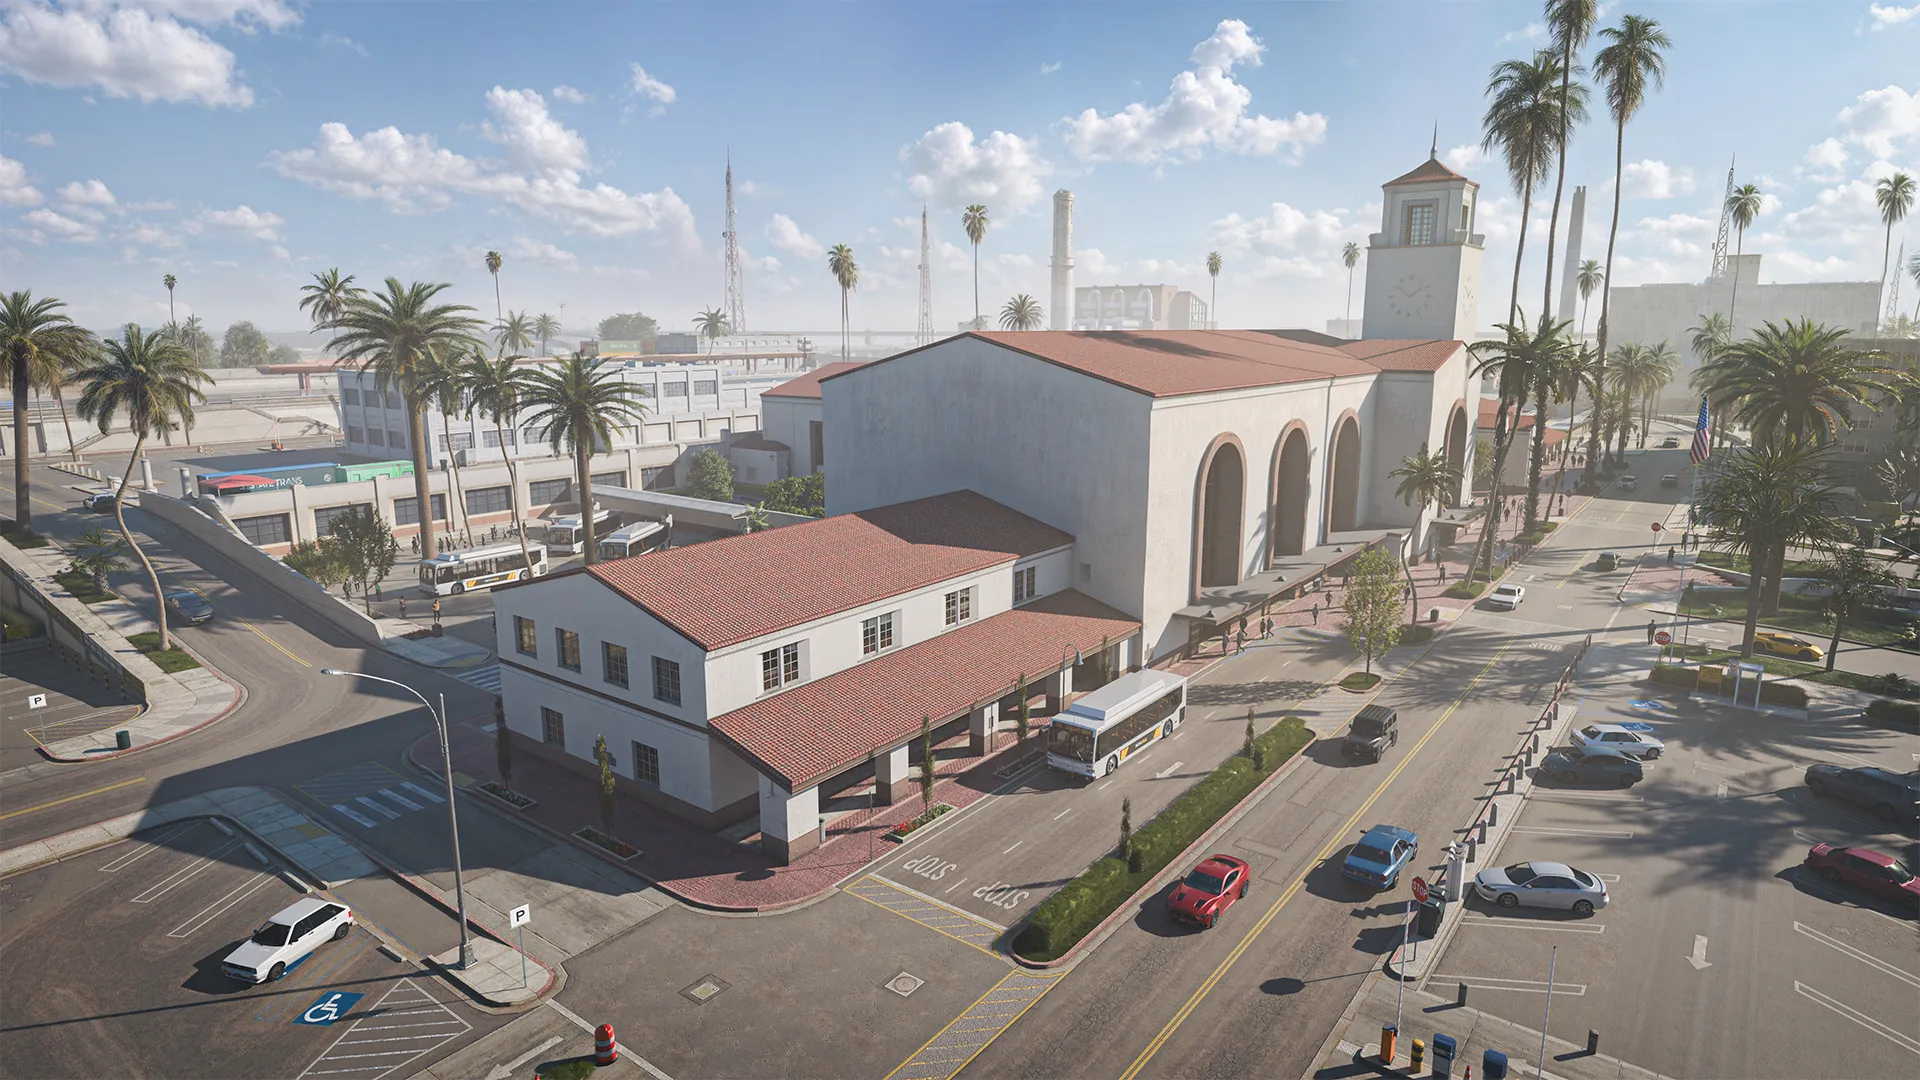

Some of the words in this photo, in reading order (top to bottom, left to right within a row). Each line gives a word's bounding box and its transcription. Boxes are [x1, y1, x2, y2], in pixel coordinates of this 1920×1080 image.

[277, 476, 303, 487] TRANS
[1655, 634, 1670, 642] STOP
[1528, 642, 1562, 652] STOP
[34, 697, 42, 705] P
[903, 854, 957, 881] STOP
[1412, 881, 1428, 897] STOP
[972, 881, 1029, 910] STOP
[516, 910, 525, 922] P
